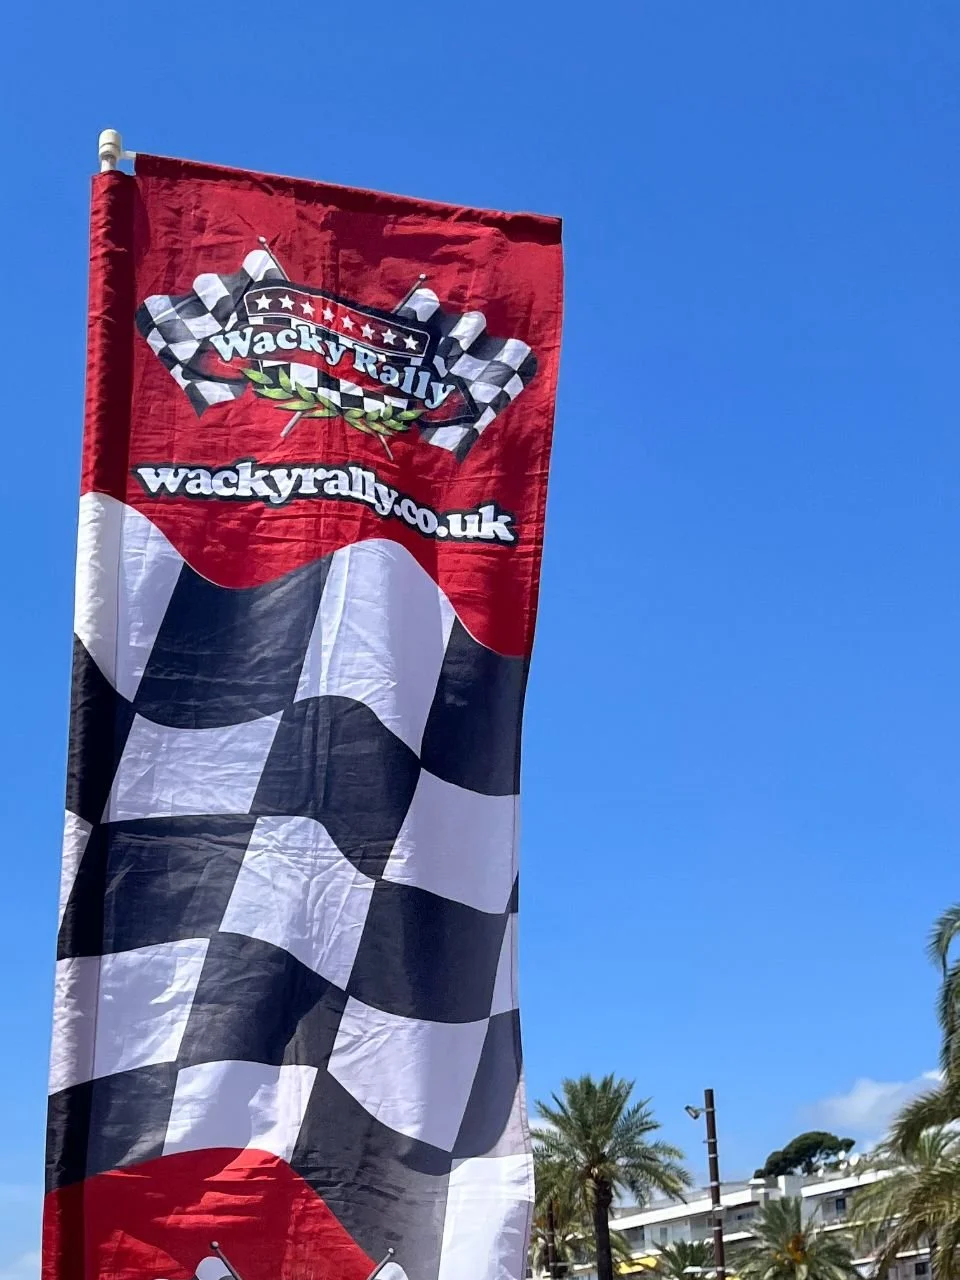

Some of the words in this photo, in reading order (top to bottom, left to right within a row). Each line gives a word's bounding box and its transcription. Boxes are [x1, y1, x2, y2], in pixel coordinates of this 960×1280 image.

[209, 325, 345, 365] Wacky
[352, 347, 457, 409] Rally
[137, 463, 515, 542] wackyrally.co.uk
